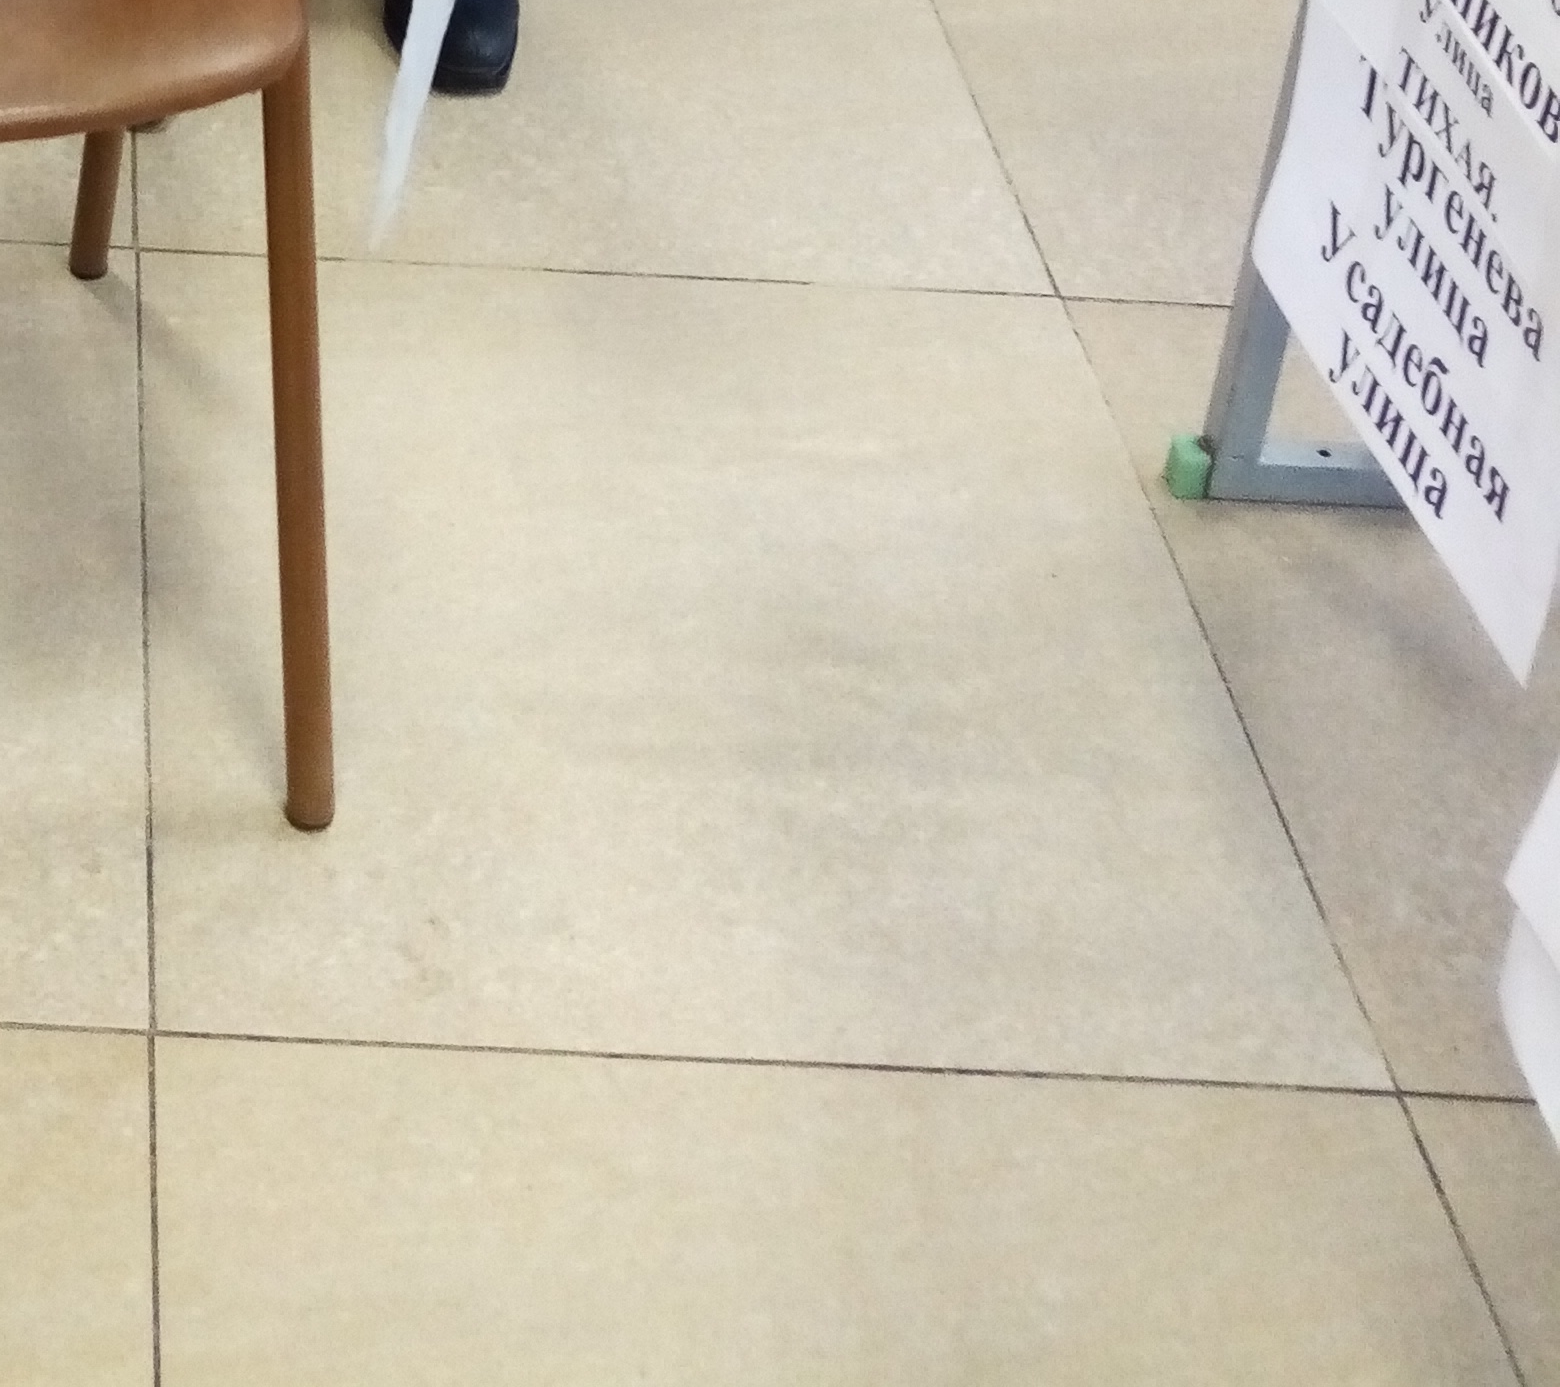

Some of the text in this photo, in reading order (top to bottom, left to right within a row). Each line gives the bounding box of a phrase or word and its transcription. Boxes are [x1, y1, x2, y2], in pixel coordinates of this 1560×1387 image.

[1359, 54, 1545, 362] Тургенева
[1374, 183, 1489, 369] улица
[1320, 197, 1511, 523] Усадебная
[1328, 327, 1448, 520] улица
